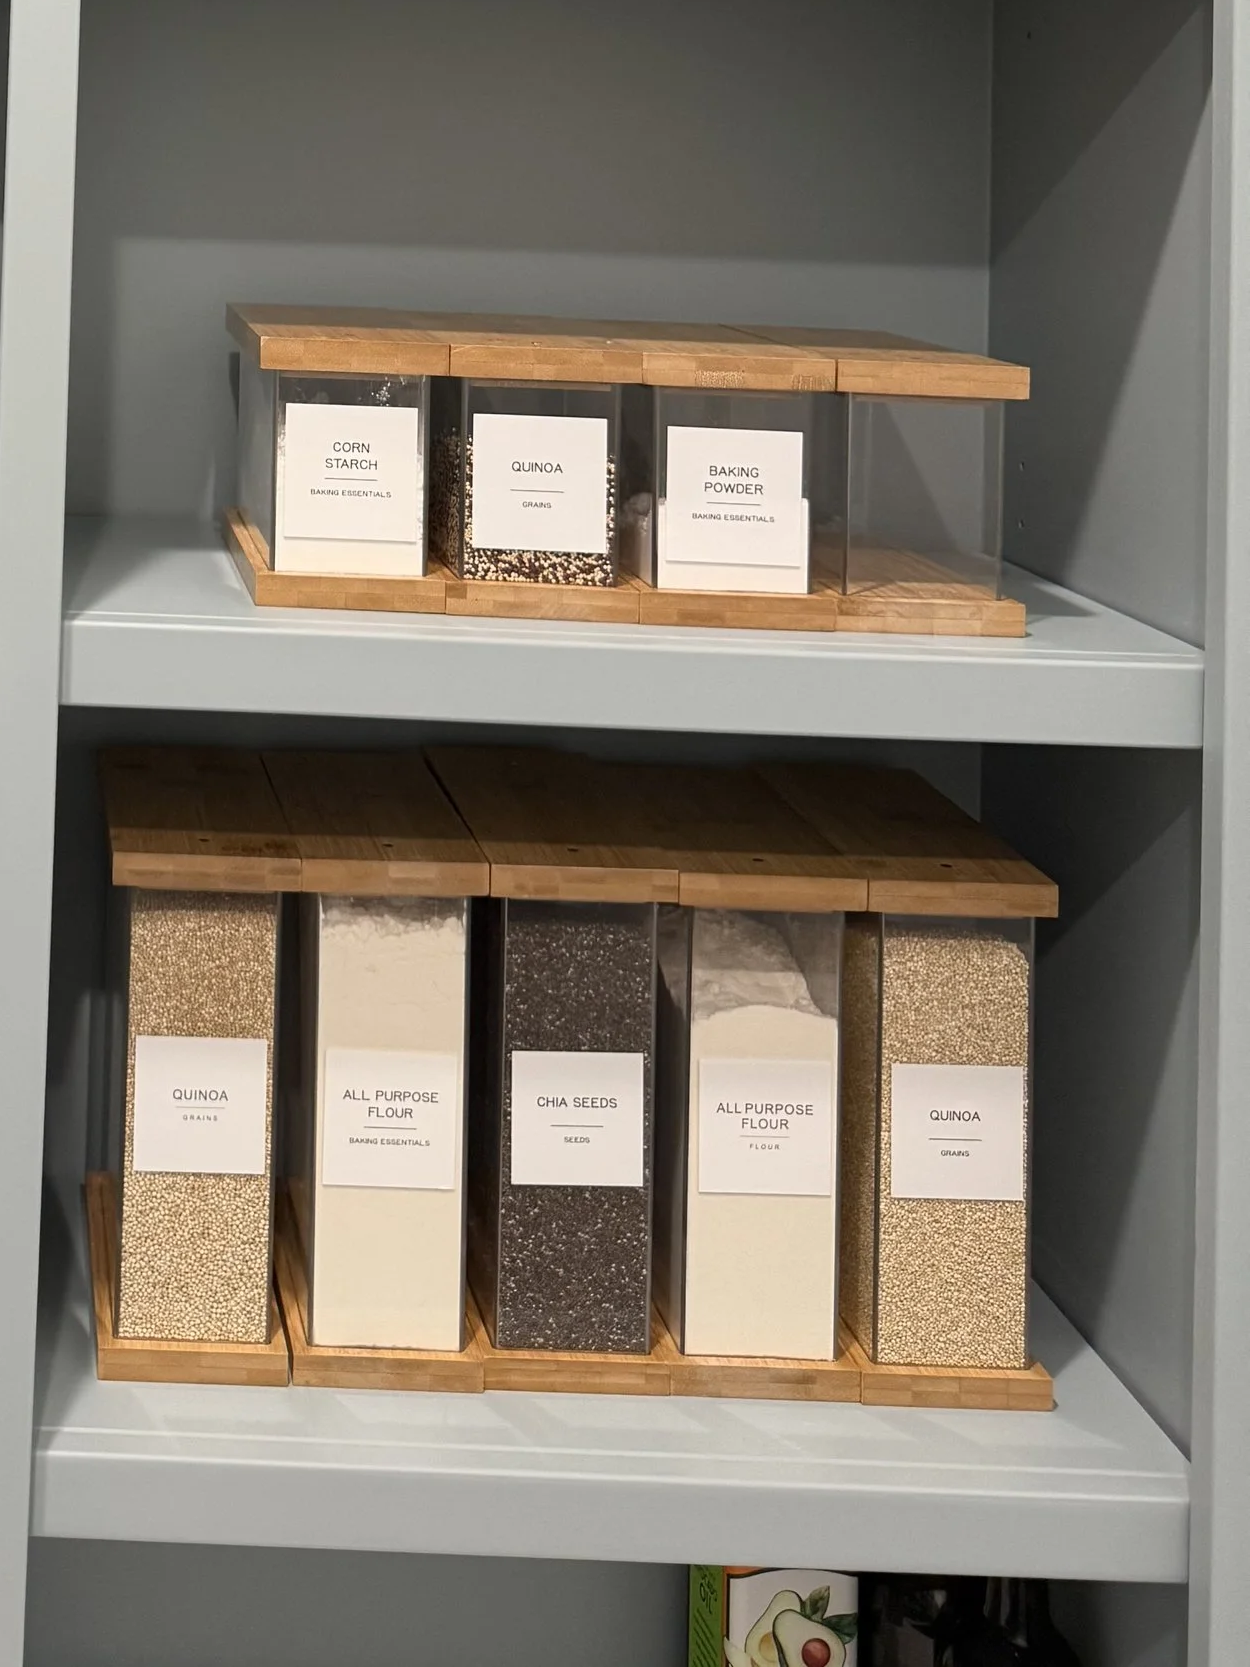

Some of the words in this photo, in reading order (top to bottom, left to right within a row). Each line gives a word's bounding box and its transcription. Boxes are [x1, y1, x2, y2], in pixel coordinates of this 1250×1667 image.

[333, 442, 370, 453] CORN
[326, 458, 377, 470] STARCH
[512, 461, 563, 473] QUINOA
[710, 466, 759, 478] BAKING
[342, 490, 391, 498] ESSENTIALS
[705, 482, 763, 495] POWDER
[724, 514, 774, 522] ESSENTIALS
[173, 1089, 228, 1101] QUINOA
[343, 1089, 370, 1101] ALL
[375, 1090, 439, 1103] PURPOSE
[537, 1097, 568, 1108] CHIA
[573, 1097, 618, 1109] SEEDS
[716, 1102, 742, 1114] ALL
[745, 1103, 814, 1115] PURPOSE
[368, 1107, 413, 1118] FLOUR
[930, 1110, 980, 1121] QUINOA
[742, 1118, 789, 1130] FLOUR
[349, 1137, 378, 1145] BAKING
[381, 1138, 430, 1146] ESSENTIALS
